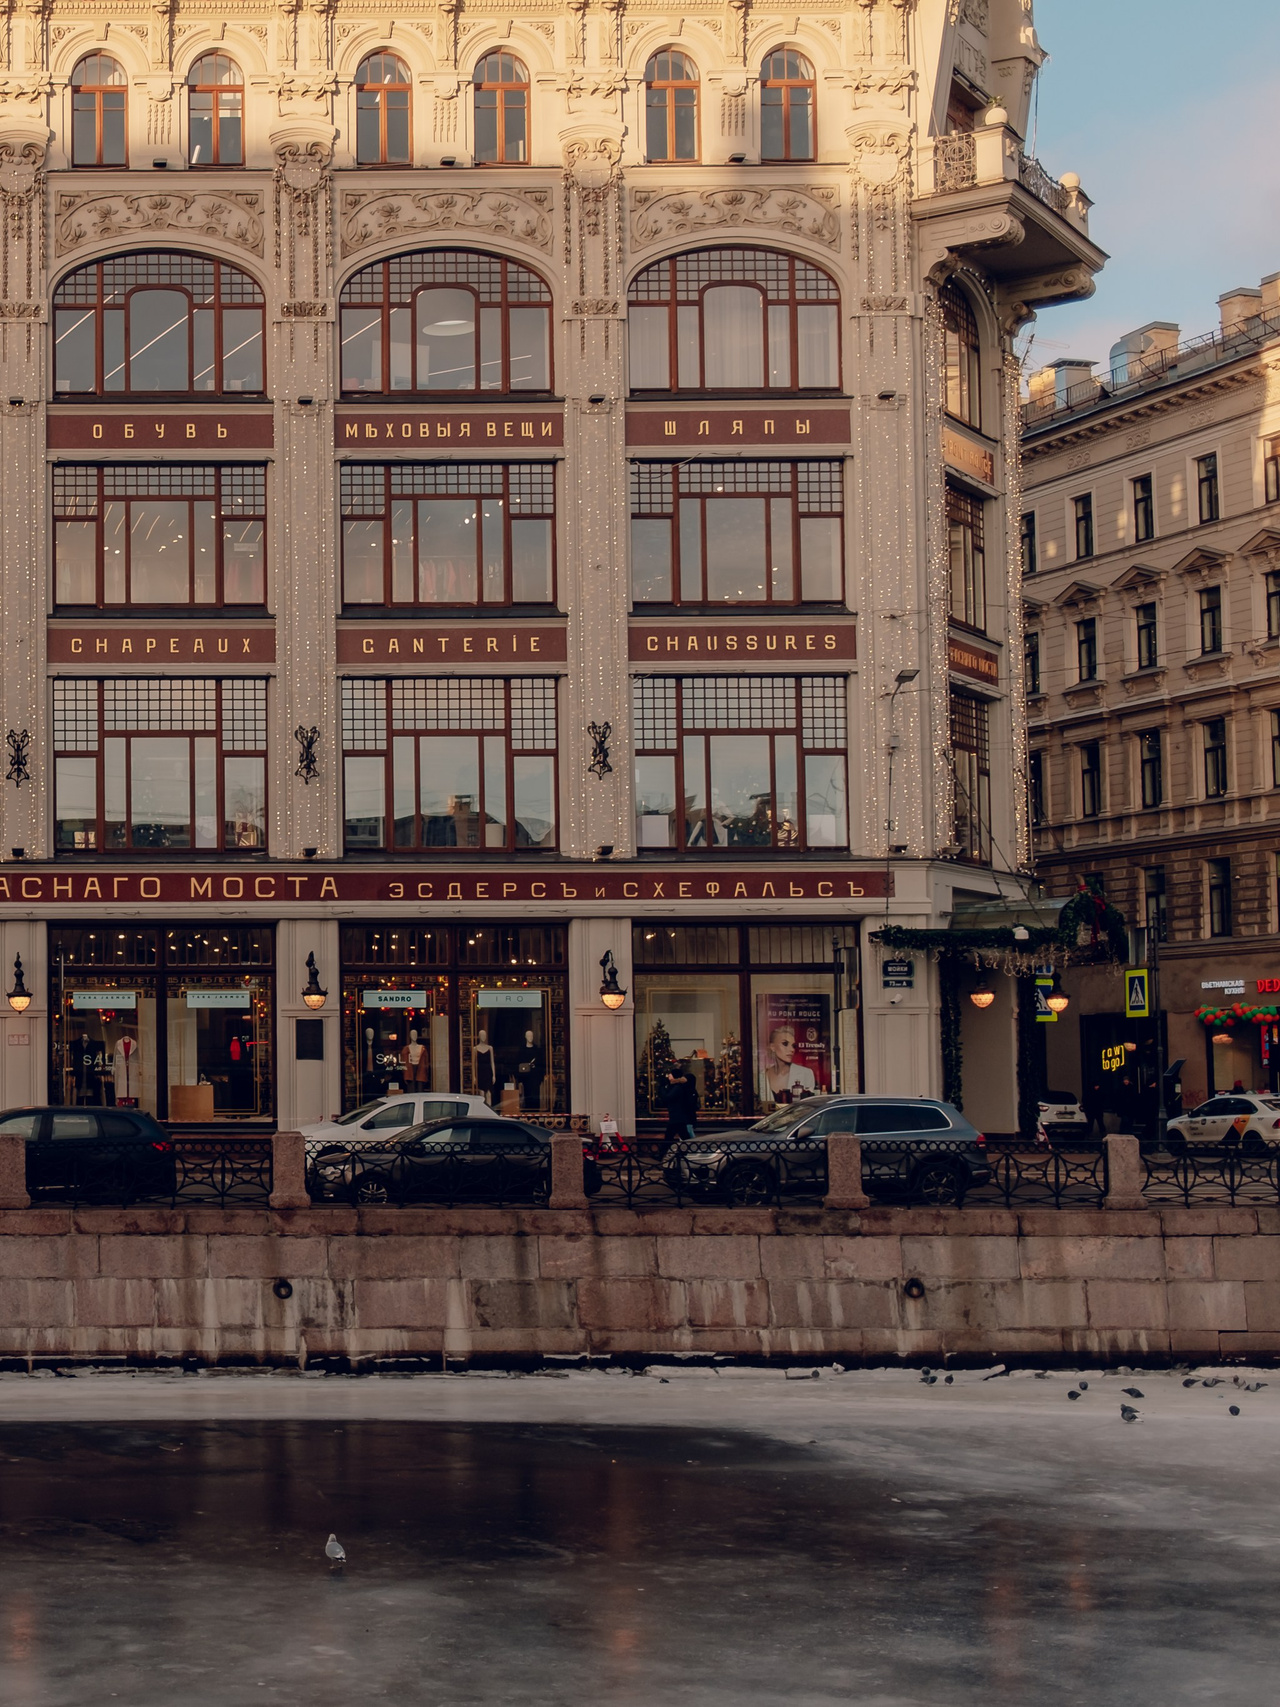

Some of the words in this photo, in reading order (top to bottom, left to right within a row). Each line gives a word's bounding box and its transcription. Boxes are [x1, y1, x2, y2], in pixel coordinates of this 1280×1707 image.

[92, 423, 228, 439] ОБУВЬ
[486, 421, 553, 440] ВЕЩИ
[664, 419, 812, 436] ШЛЯПЫ
[71, 638, 251, 653] CHAPEAUX
[646, 634, 838, 651] CHAUSSURES
[190, 877, 338, 898] МОСТА
[389, 882, 577, 899] ЭСДЕРСЪ
[623, 881, 865, 897] СХЕФАЛЬСЪ
[377, 995, 412, 1003] SANDRO
[495, 995, 524, 1003] IRO
[82, 1053, 124, 1066] SALE
